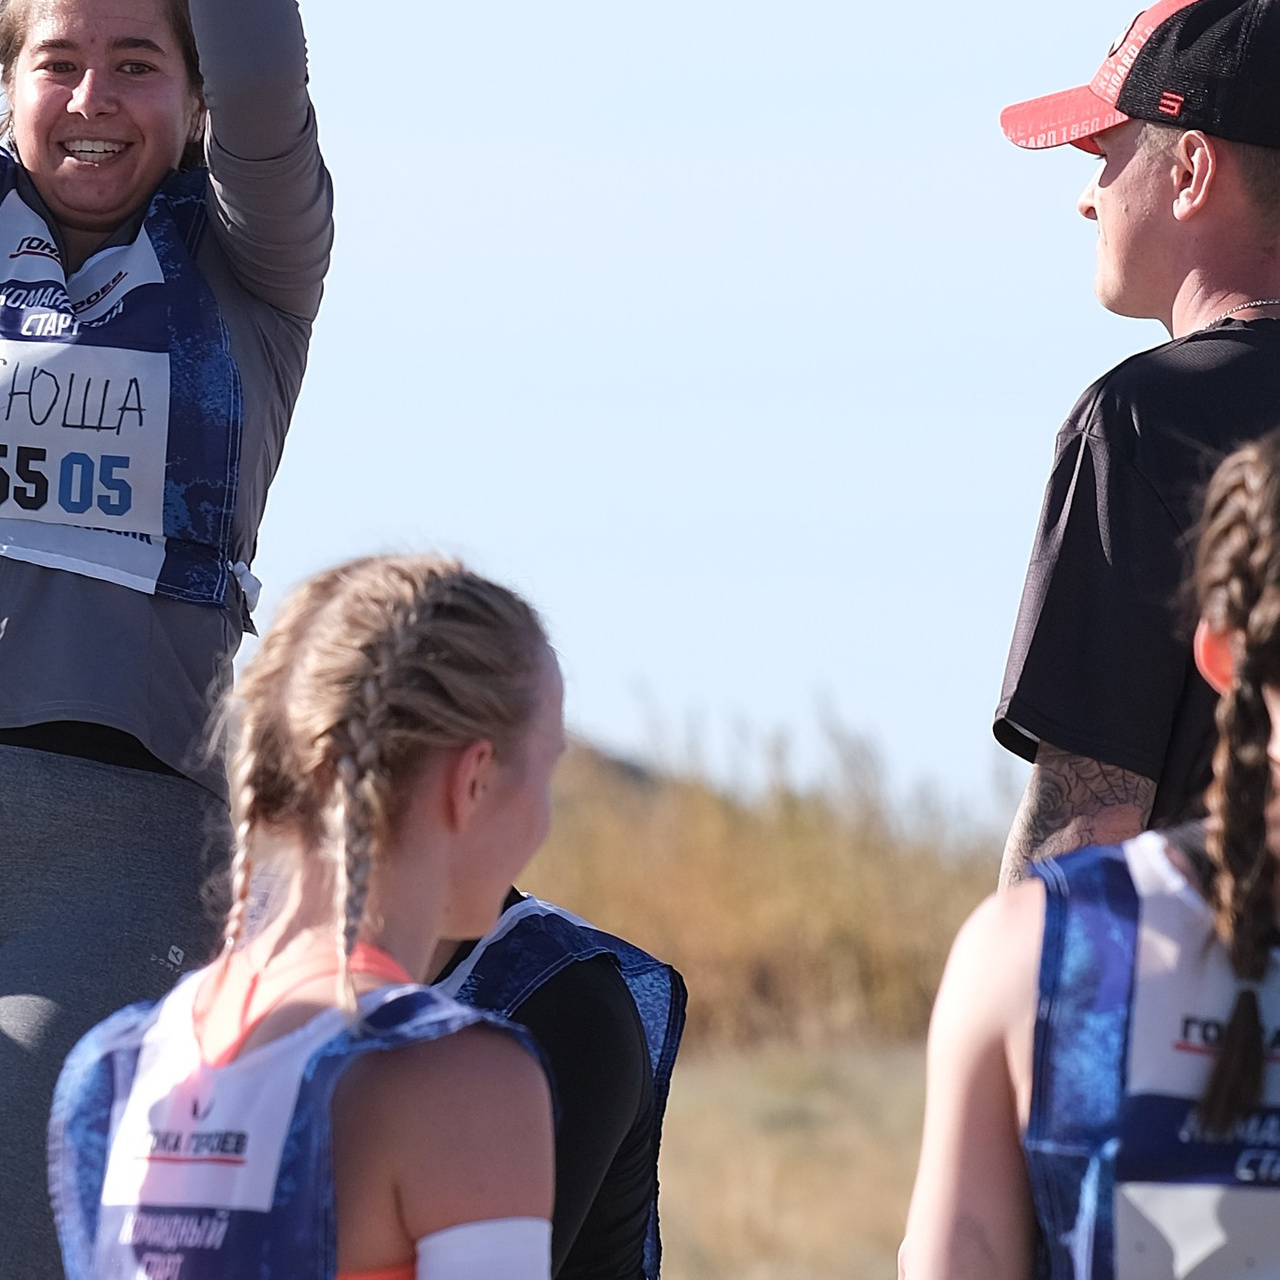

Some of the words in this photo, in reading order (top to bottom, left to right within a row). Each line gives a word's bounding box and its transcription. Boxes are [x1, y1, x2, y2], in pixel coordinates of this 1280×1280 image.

[17, 236, 60, 259] ГОН
[72, 271, 123, 314] РОЕВ
[21, 312, 82, 336] СТАРТ
